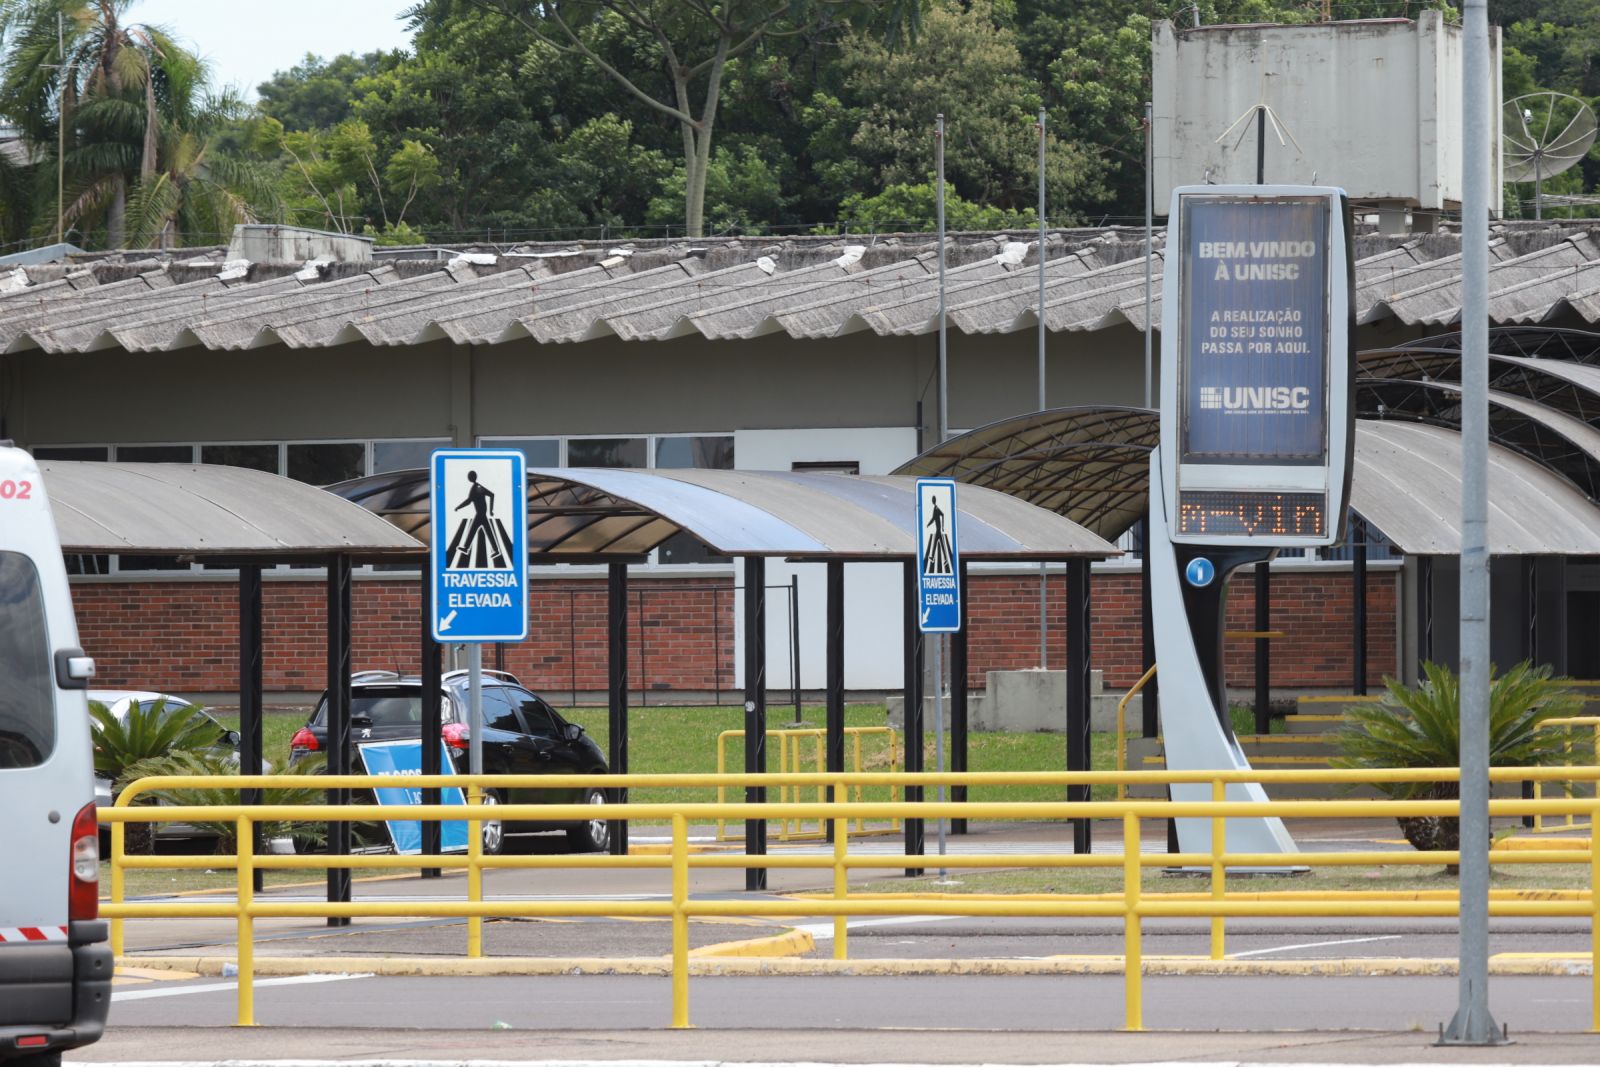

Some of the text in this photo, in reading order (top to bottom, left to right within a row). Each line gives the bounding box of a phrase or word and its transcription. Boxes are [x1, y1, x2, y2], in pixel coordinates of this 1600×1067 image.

[1199, 241, 1316, 258] BEM-VINDO
[1214, 260, 1300, 281] À UNISC
[1211, 308, 1301, 325] A REALIZAÇÃO
[1210, 326, 1303, 338] DO SEU SONHO
[1201, 342, 1311, 354] PASSA POR AQUI.
[1223, 386, 1310, 409] UNISC
[442, 573, 518, 588] TRAVESSIA
[922, 577, 956, 590] TRAVESSIA
[448, 593, 512, 608] ELEVADA
[925, 593, 954, 606] ELEVADA
